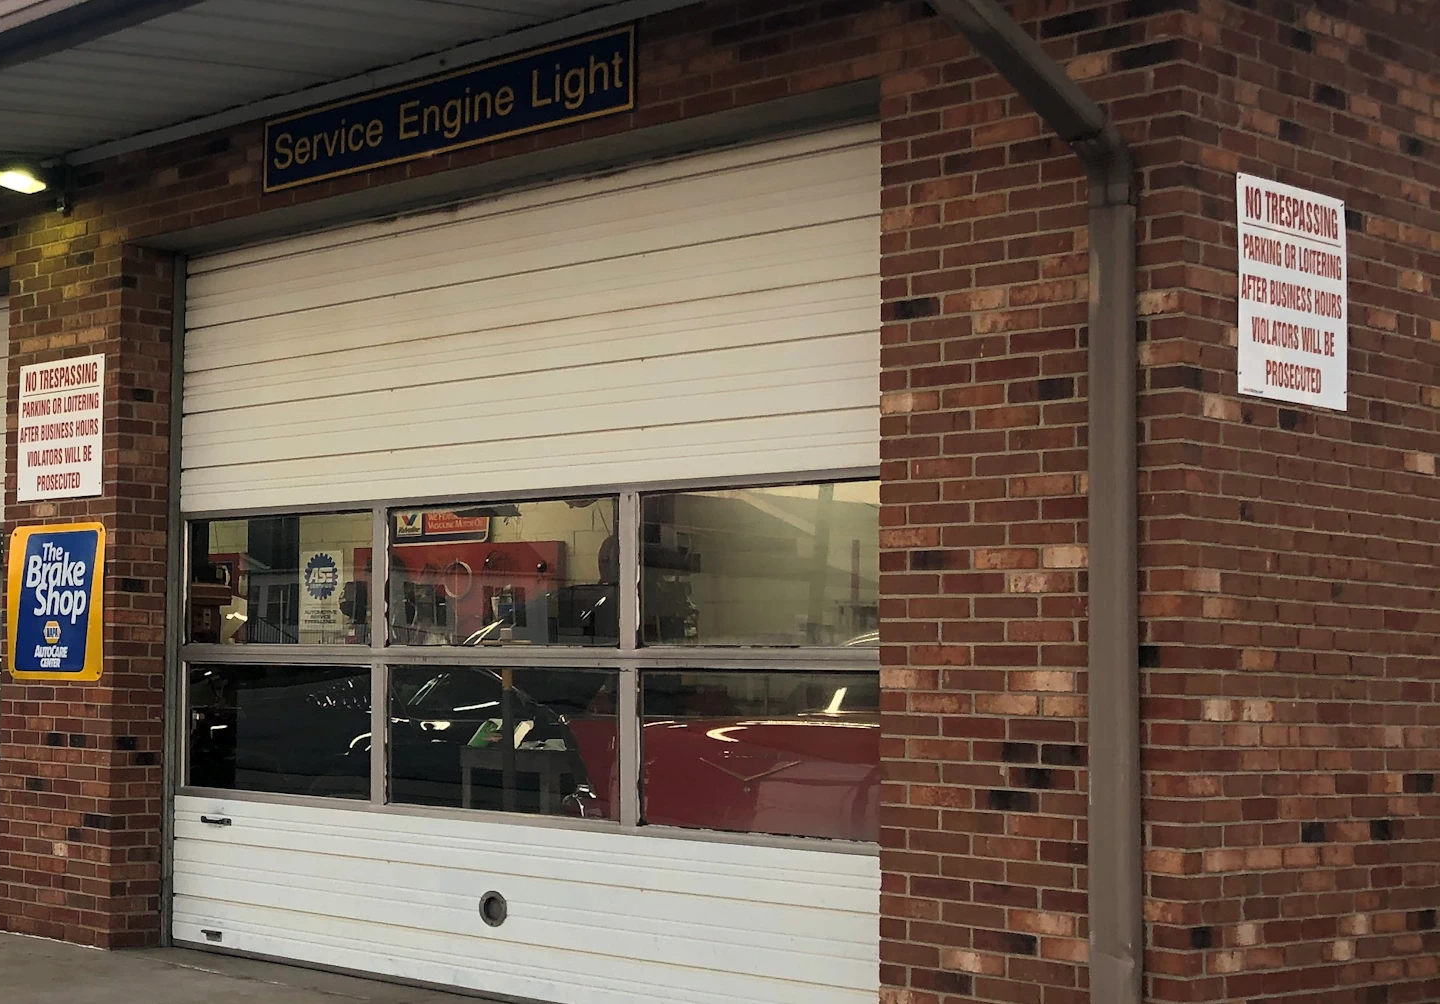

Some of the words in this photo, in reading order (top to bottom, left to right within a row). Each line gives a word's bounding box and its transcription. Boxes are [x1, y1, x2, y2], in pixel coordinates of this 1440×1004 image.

[273, 117, 384, 170] Service
[398, 85, 514, 139] Engine
[531, 51, 624, 110] Light
[1245, 185, 1262, 221] NO
[1265, 190, 1338, 240] TRESPASSING
[1243, 233, 1282, 268] PARKING
[1284, 242, 1297, 270] OR
[1298, 246, 1342, 281] LOITERING
[1241, 273, 1268, 303] AFTER
[1270, 279, 1312, 314] BUSINESS
[1314, 290, 1342, 320] HOURS
[1251, 316, 1299, 351] VIOLATORS
[1301, 327, 1322, 355] WILL
[1324, 331, 1335, 357] BE
[25, 371, 37, 393] NO
[39, 361, 98, 391] TRESPASSING
[1265, 359, 1322, 394] PROSECUTED
[22, 399, 51, 419] PARKING
[52, 397, 62, 415] OR
[63, 392, 99, 414] LOITERING
[20, 425, 39, 444] AFTER
[40, 421, 74, 441] BUSINESS
[75, 418, 99, 437] HOURS
[27, 447, 63, 468] VIOLATORS
[64, 446, 81, 464] WILL
[82, 445, 92, 462] BE
[36, 472, 81, 492] PROSECUTED
[42, 541, 64, 562] The
[26, 551, 86, 588] Brake
[308, 567, 333, 584] ASE
[33, 582, 87, 625] Shop
[40, 658, 61, 668] CENTER
